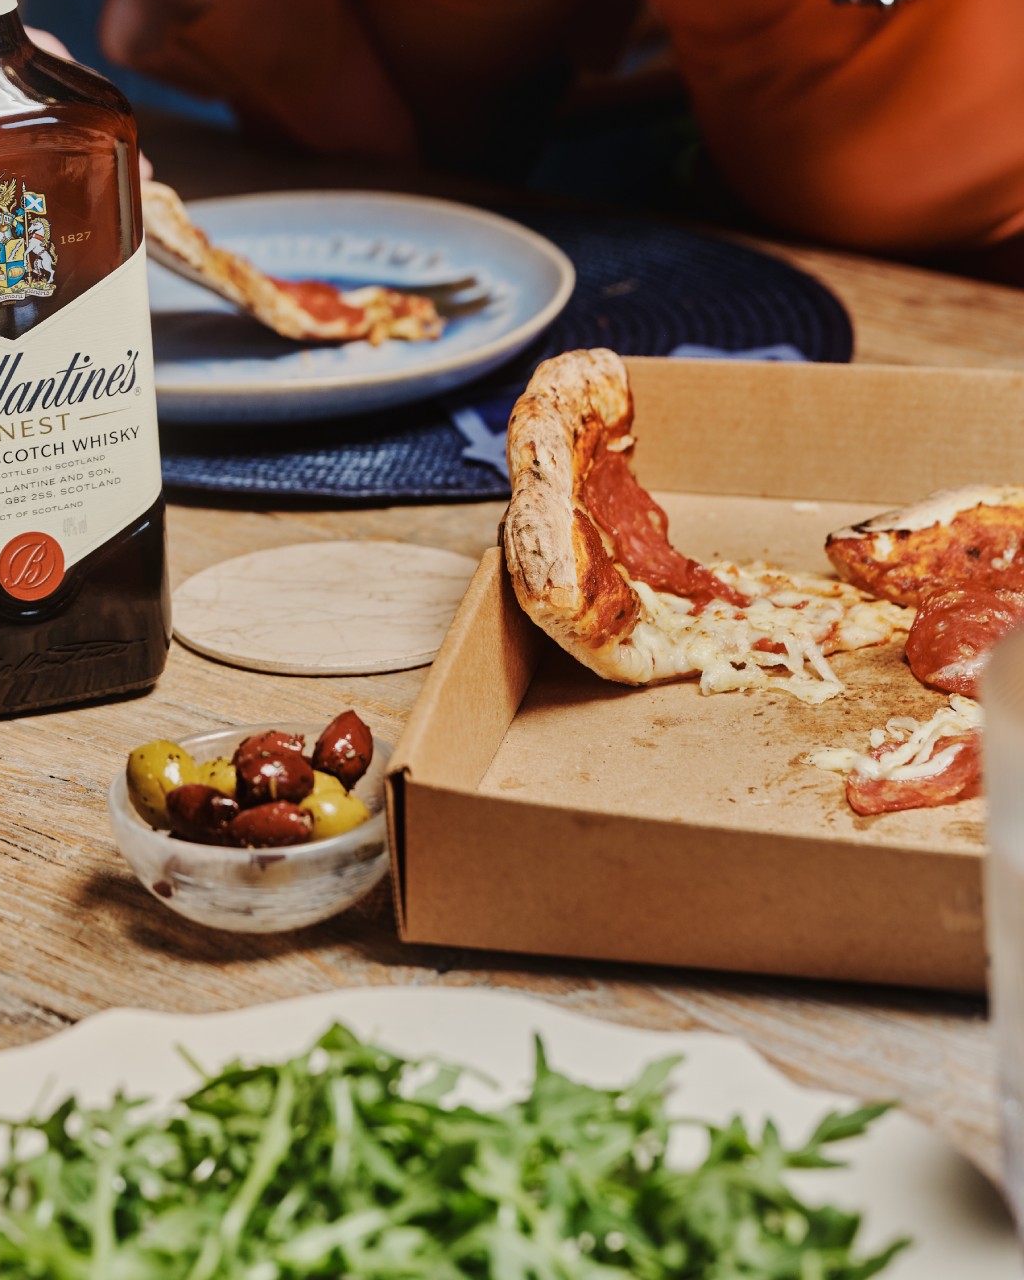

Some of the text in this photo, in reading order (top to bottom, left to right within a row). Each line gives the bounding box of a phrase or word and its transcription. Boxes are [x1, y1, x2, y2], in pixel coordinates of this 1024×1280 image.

[60, 231, 92, 245] 1827
[72, 425, 140, 453] WHISKY
[55, 454, 106, 470] SCOTLAND
[59, 473, 84, 484] AND
[60, 477, 122, 496] SCOTLAND
[15, 510, 29, 518] OF
[32, 500, 84, 516] SCOTLAND
[4, 541, 56, 590] B
